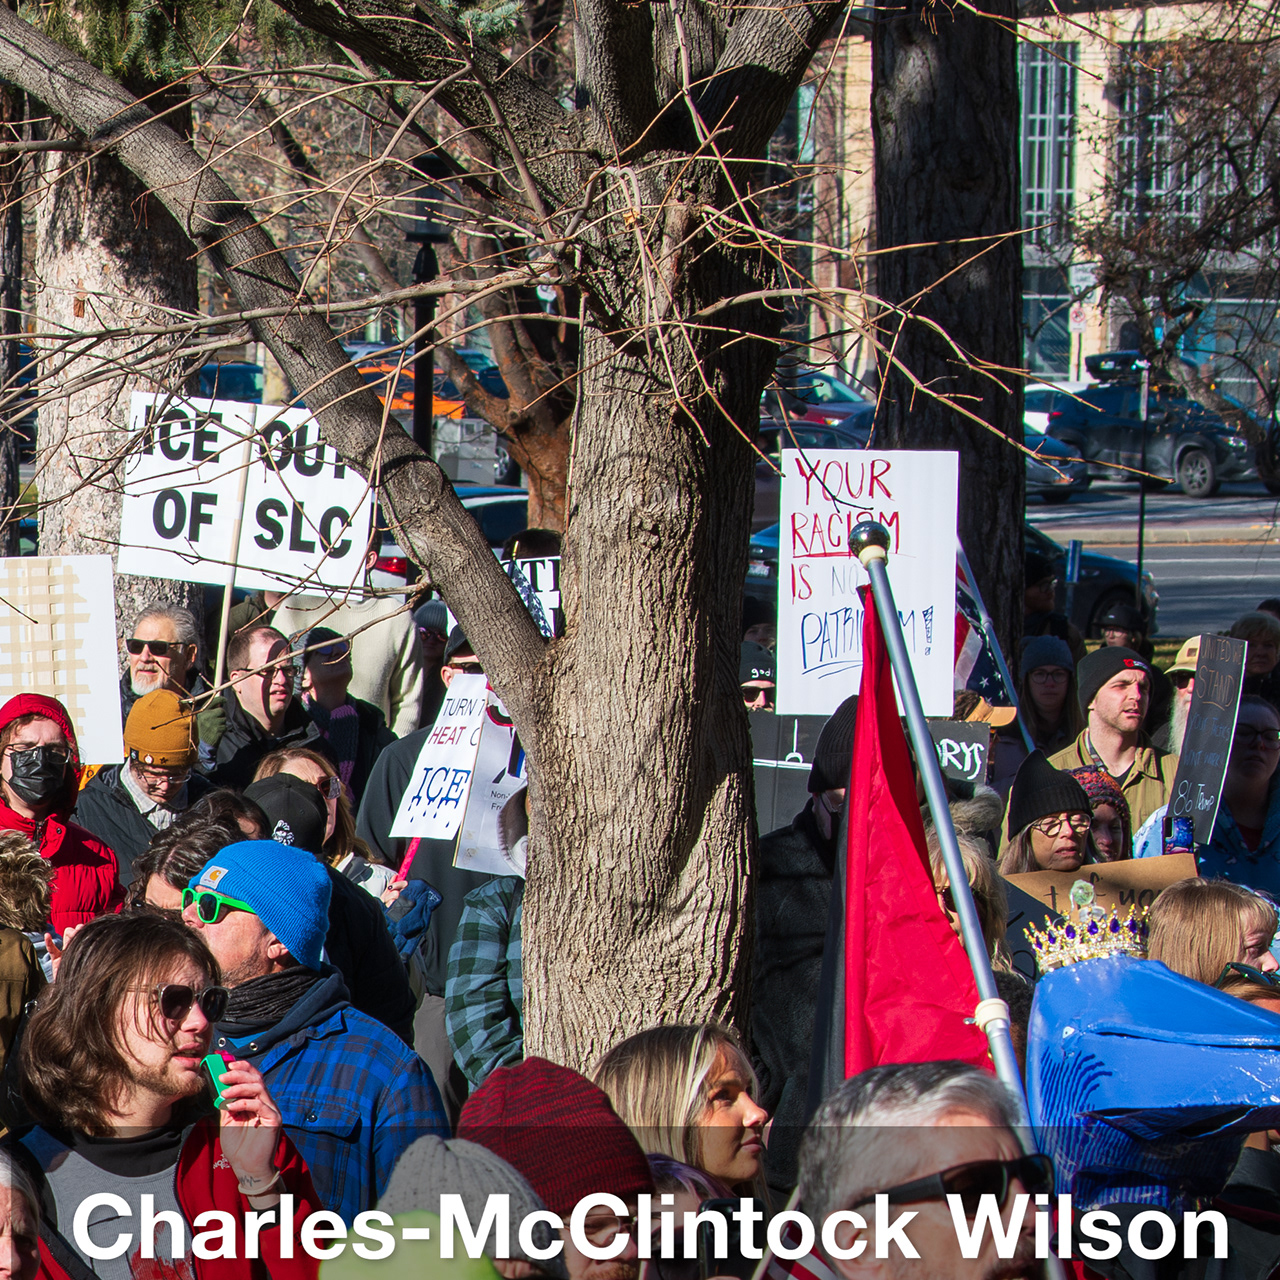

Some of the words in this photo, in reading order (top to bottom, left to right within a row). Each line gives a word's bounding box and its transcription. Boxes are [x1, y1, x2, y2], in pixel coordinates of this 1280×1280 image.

[143, 404, 223, 463] ICE
[795, 457, 895, 505] YOUR
[152, 488, 218, 543] OF
[254, 498, 352, 559] SLC
[791, 511, 900, 559] RACIM
[791, 563, 812, 605] IS
[831, 563, 859, 597] NO
[443, 698, 475, 717] TURN
[428, 726, 466, 745] HEAT
[412, 767, 472, 804] ICE
